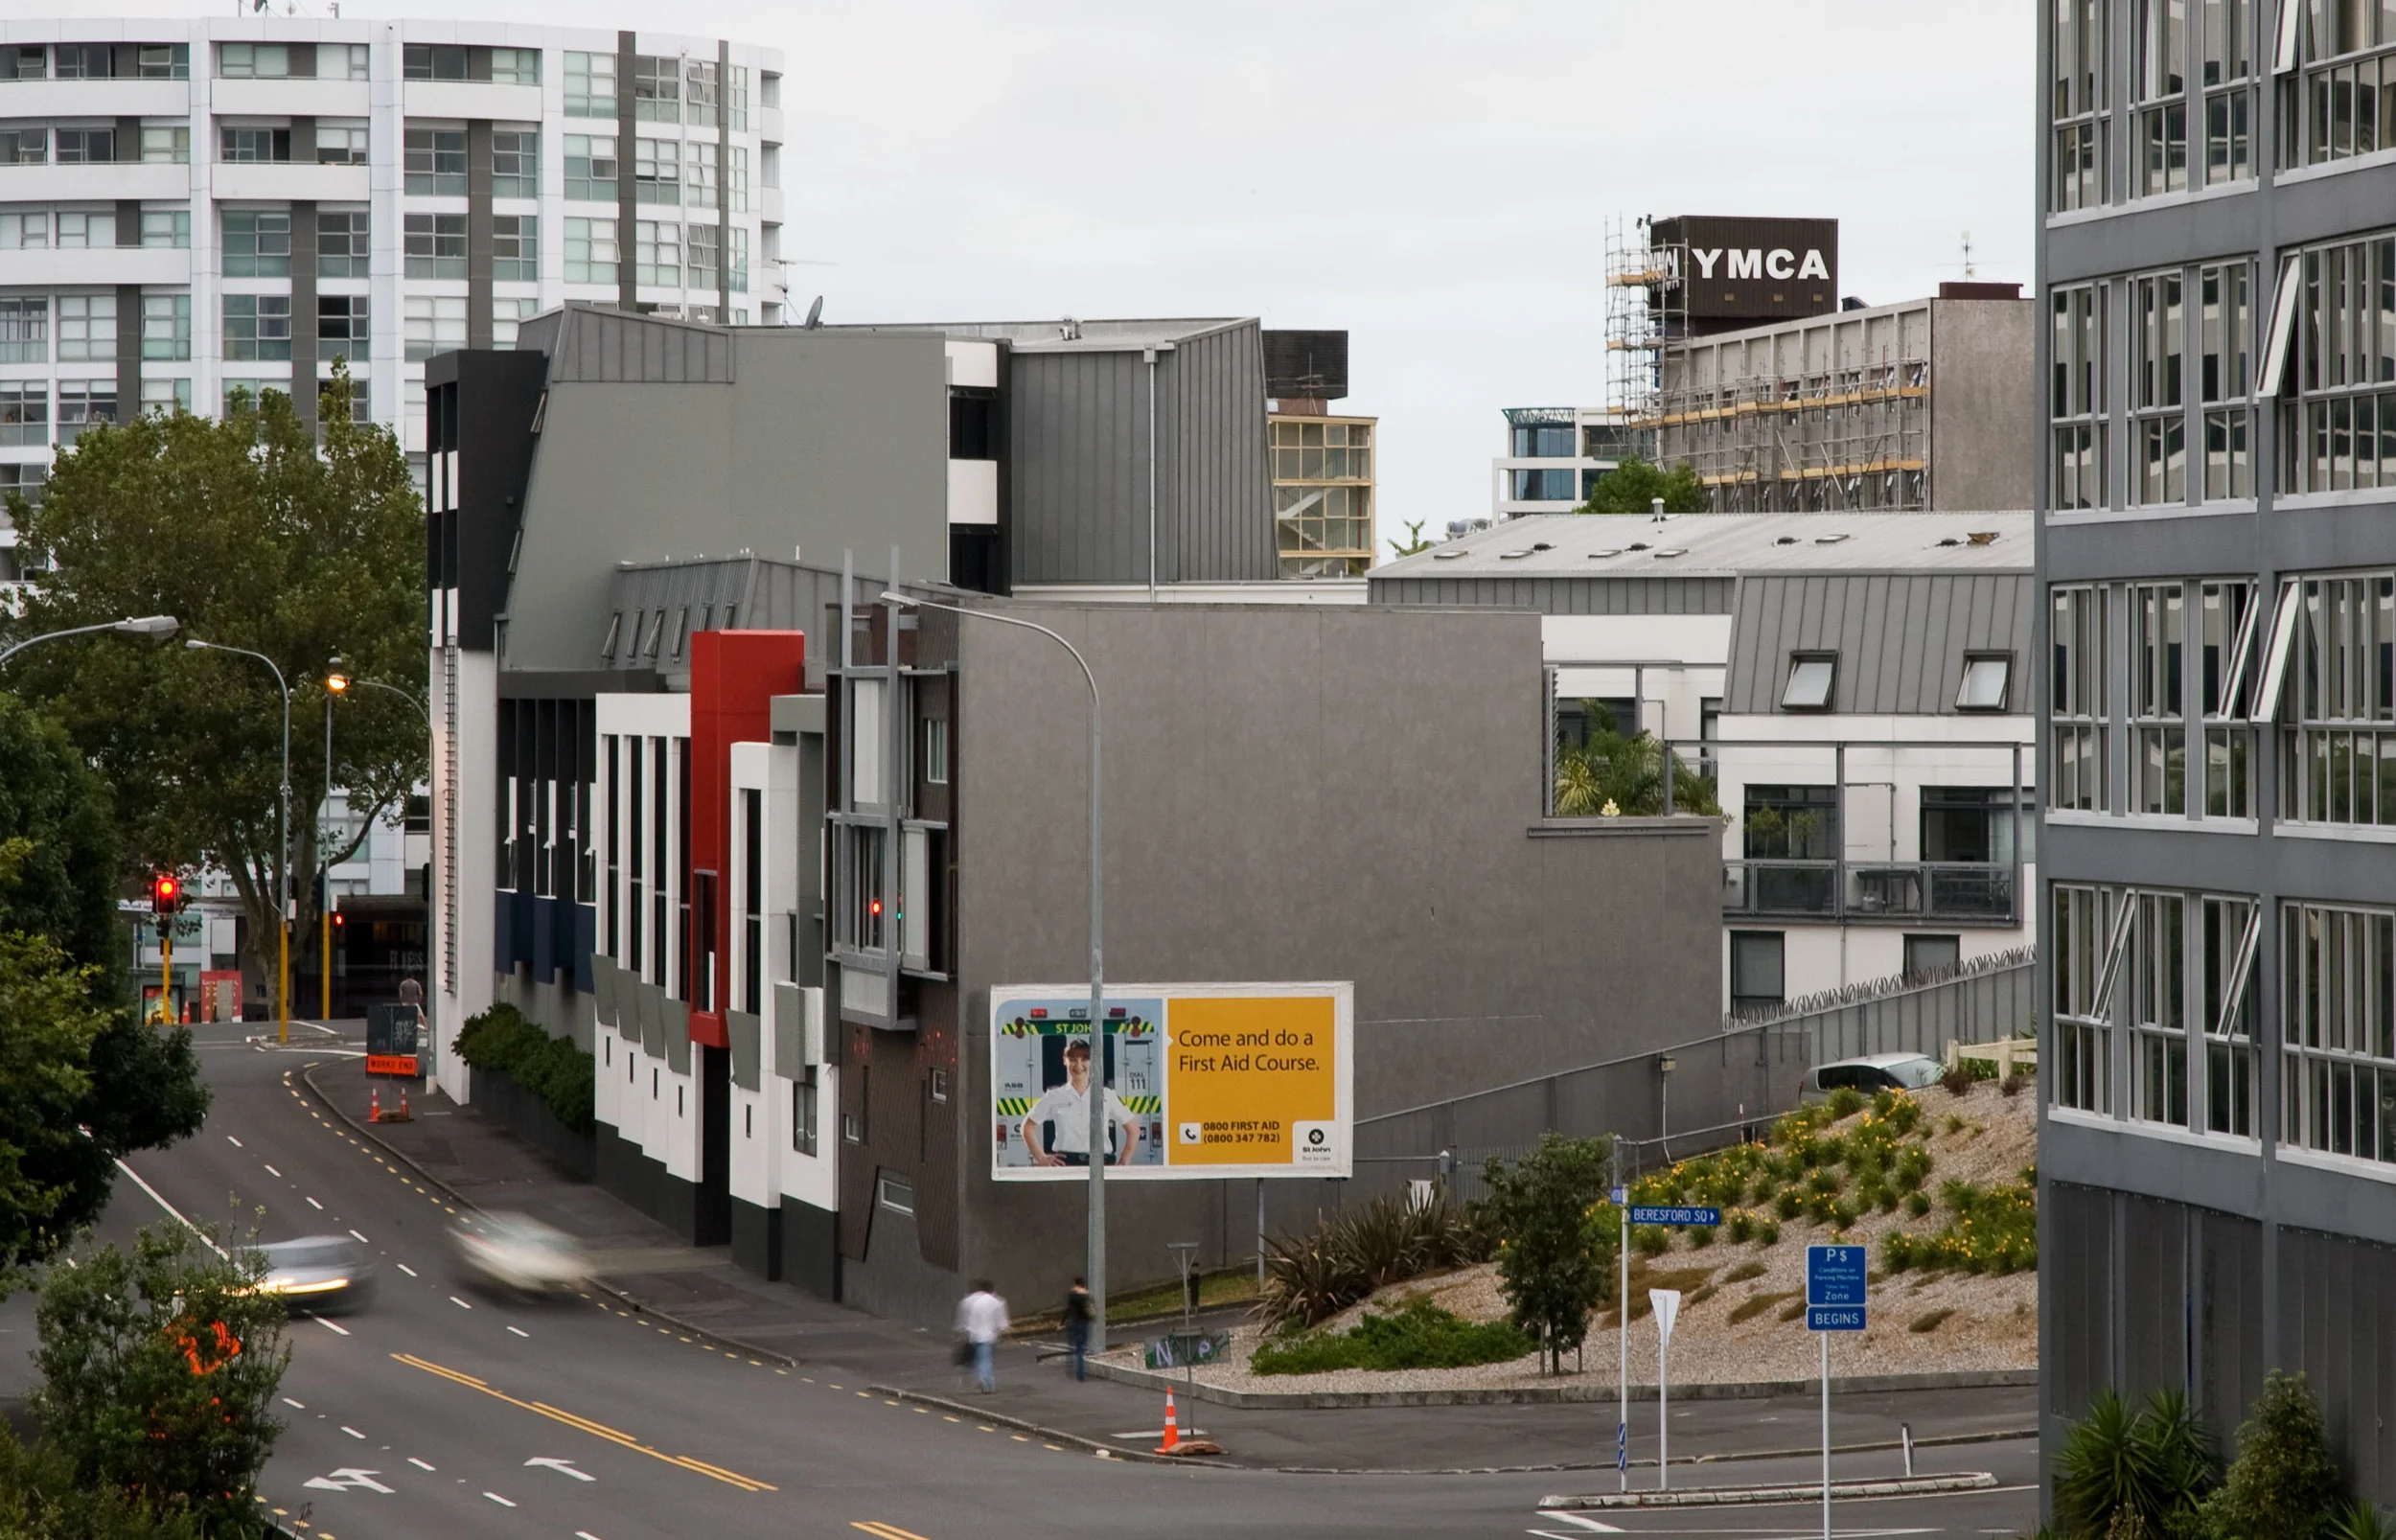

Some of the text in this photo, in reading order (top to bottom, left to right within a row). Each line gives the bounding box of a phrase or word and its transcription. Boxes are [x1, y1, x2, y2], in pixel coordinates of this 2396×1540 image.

[1691, 248, 1830, 280] YMCA
[1055, 1023, 1093, 1033] ST JOH
[1179, 1029, 1313, 1046] Come and do a
[1179, 1054, 1320, 1071] First Aid Course.
[1131, 1078, 1145, 1090] 111
[1204, 1121, 1279, 1131] 0800 FIRST AID
[1204, 1134, 1280, 1143] (0800 347 782)
[1634, 1208, 1708, 1222] BERESFORD SQ
[1827, 1249, 1835, 1262] P
[1825, 1292, 1850, 1300] Zone
[1815, 1313, 1859, 1324] BEGINS
